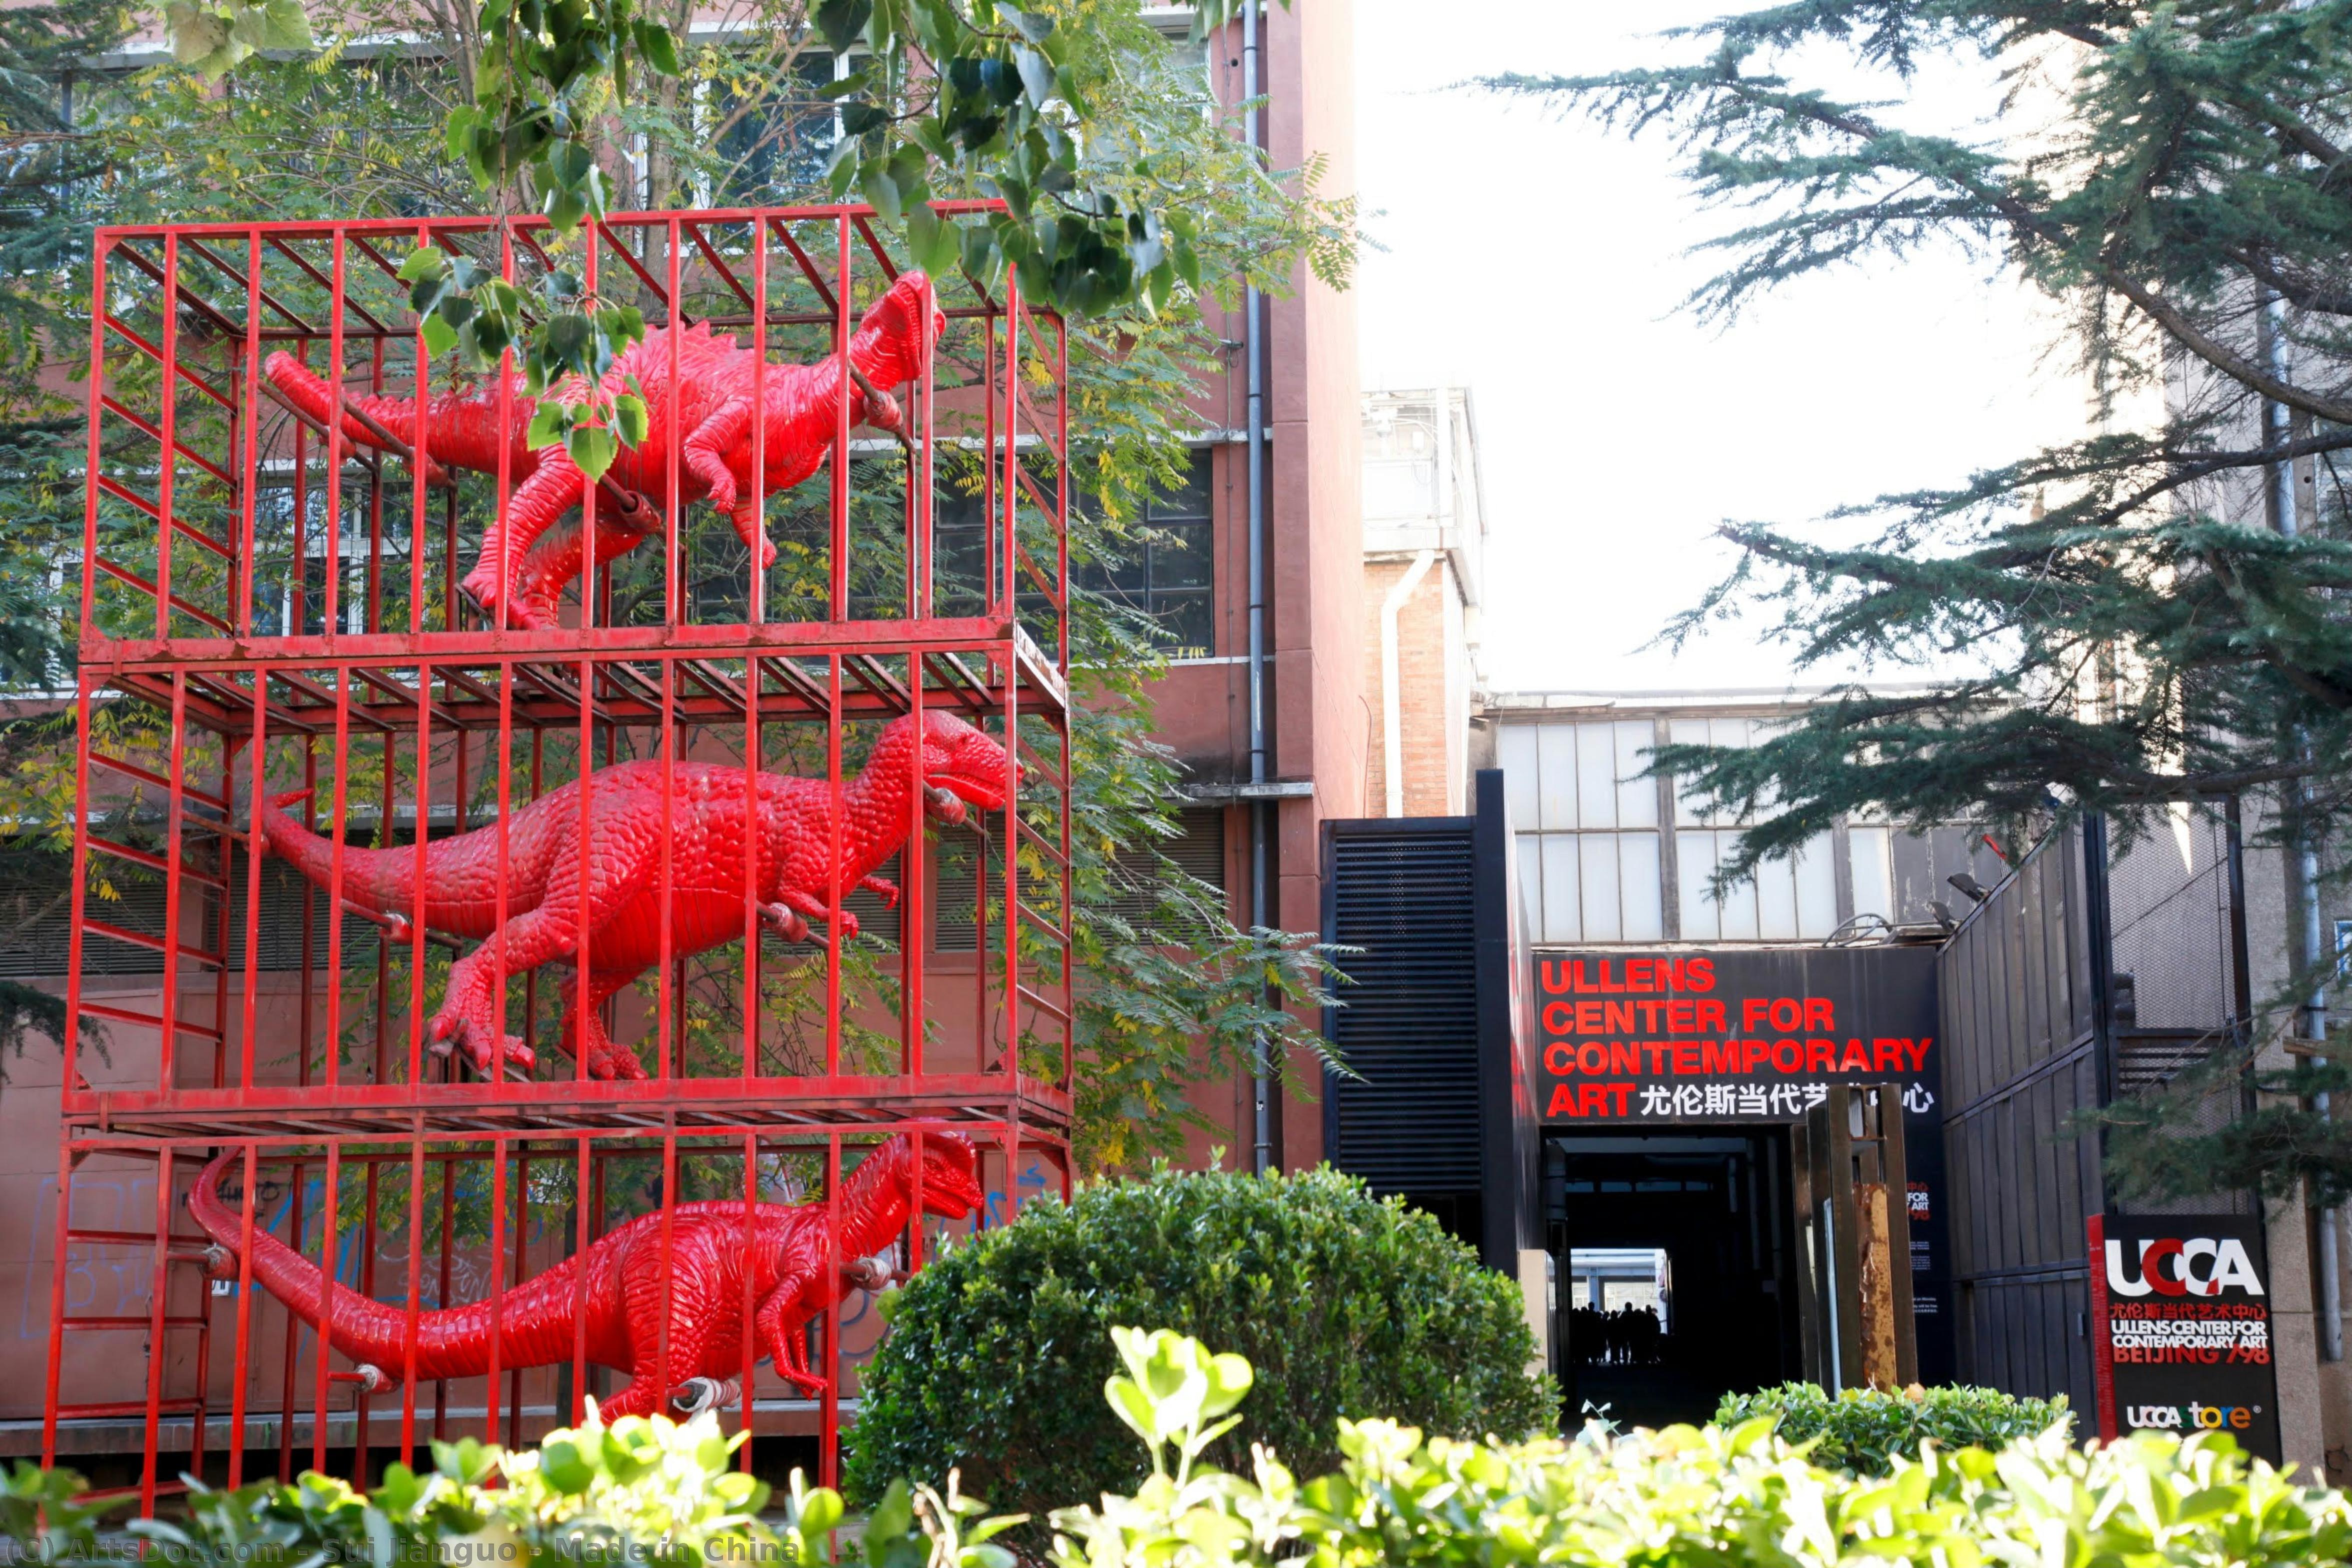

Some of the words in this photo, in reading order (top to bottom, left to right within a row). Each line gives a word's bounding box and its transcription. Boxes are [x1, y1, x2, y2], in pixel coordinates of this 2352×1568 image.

[1542, 958, 1716, 994] ULLENS
[1542, 999, 1727, 1036] CENTER
[1743, 998, 1834, 1032] FOR
[1544, 1038, 1932, 1076] CONTEMPORARY
[1546, 1082, 1636, 1117] ART
[1640, 1082, 1934, 1116] 尤伦斯当代艺心
[1908, 1192, 1928, 1202] FOR
[1912, 1202, 1929, 1210] ART
[2105, 1238, 2265, 1296] UCCA
[2110, 1303, 2267, 1320] 尤伦斯当代艺术中心
[2111, 1320, 2171, 1334] ULLENS
[2171, 1320, 2232, 1334] CENTER
[2232, 1322, 2266, 1336] FOR
[2112, 1335, 2236, 1348] CONTEMPORARY
[2240, 1336, 2268, 1348] ART
[2114, 1345, 2220, 1364] BEIJING
